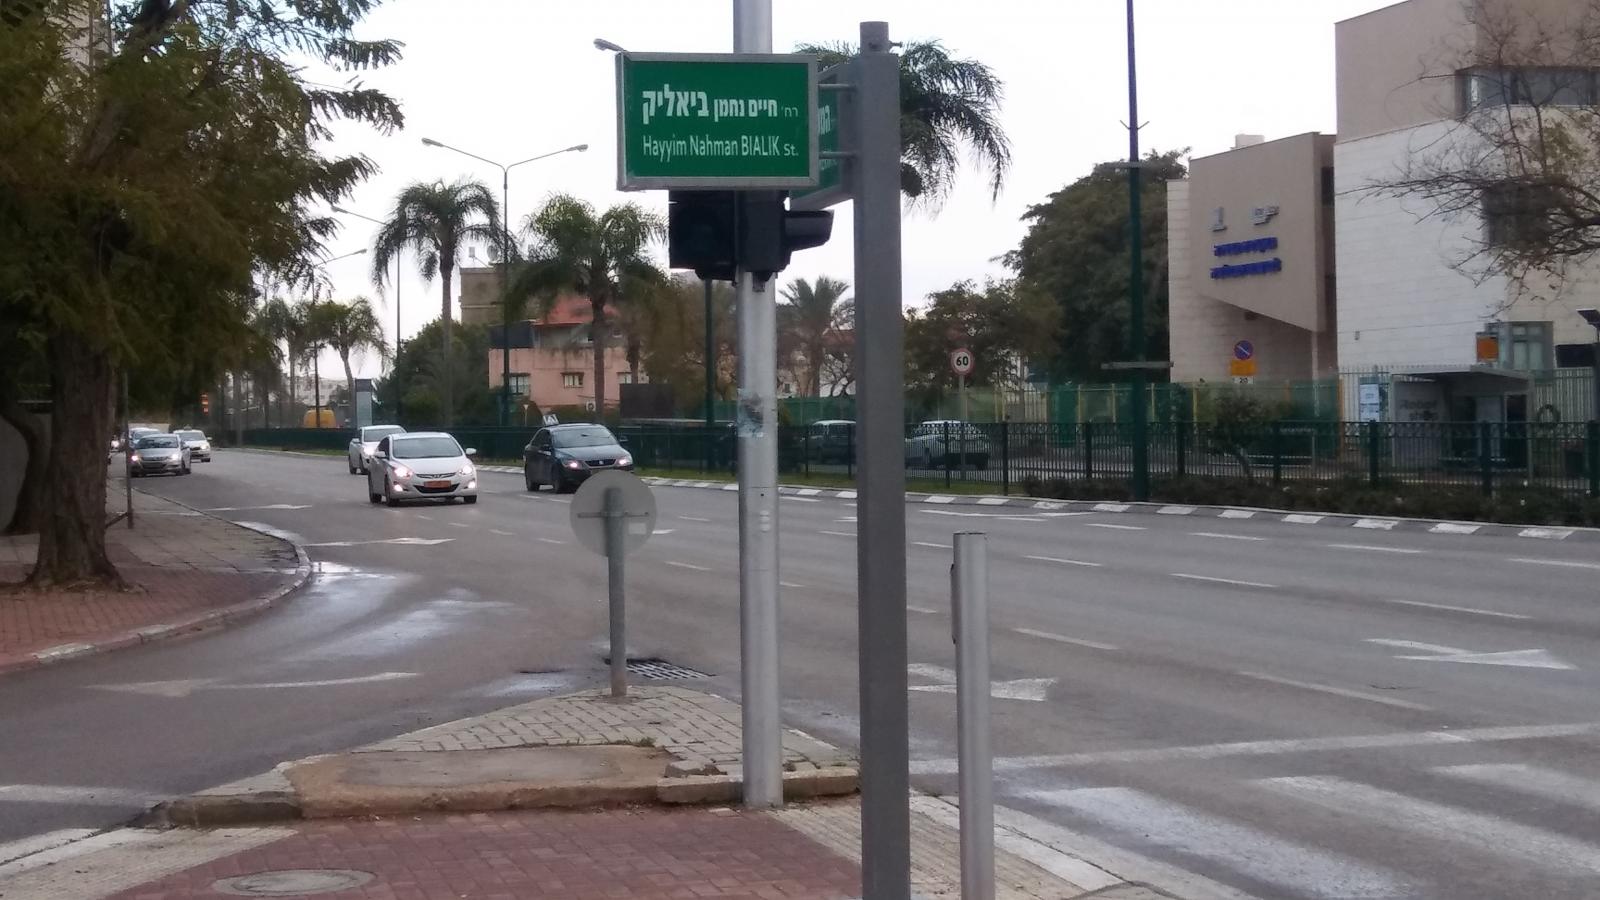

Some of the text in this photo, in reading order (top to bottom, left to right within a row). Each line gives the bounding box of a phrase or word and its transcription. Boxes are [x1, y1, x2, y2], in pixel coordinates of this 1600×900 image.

[642, 83, 709, 125] ביאליק
[714, 99, 745, 123] נחמן
[748, 99, 778, 117] חיים
[643, 133, 687, 163] Hayyim
[690, 134, 738, 156] Nahman
[741, 134, 780, 156] BIALIK
[956, 356, 969, 366] 60
